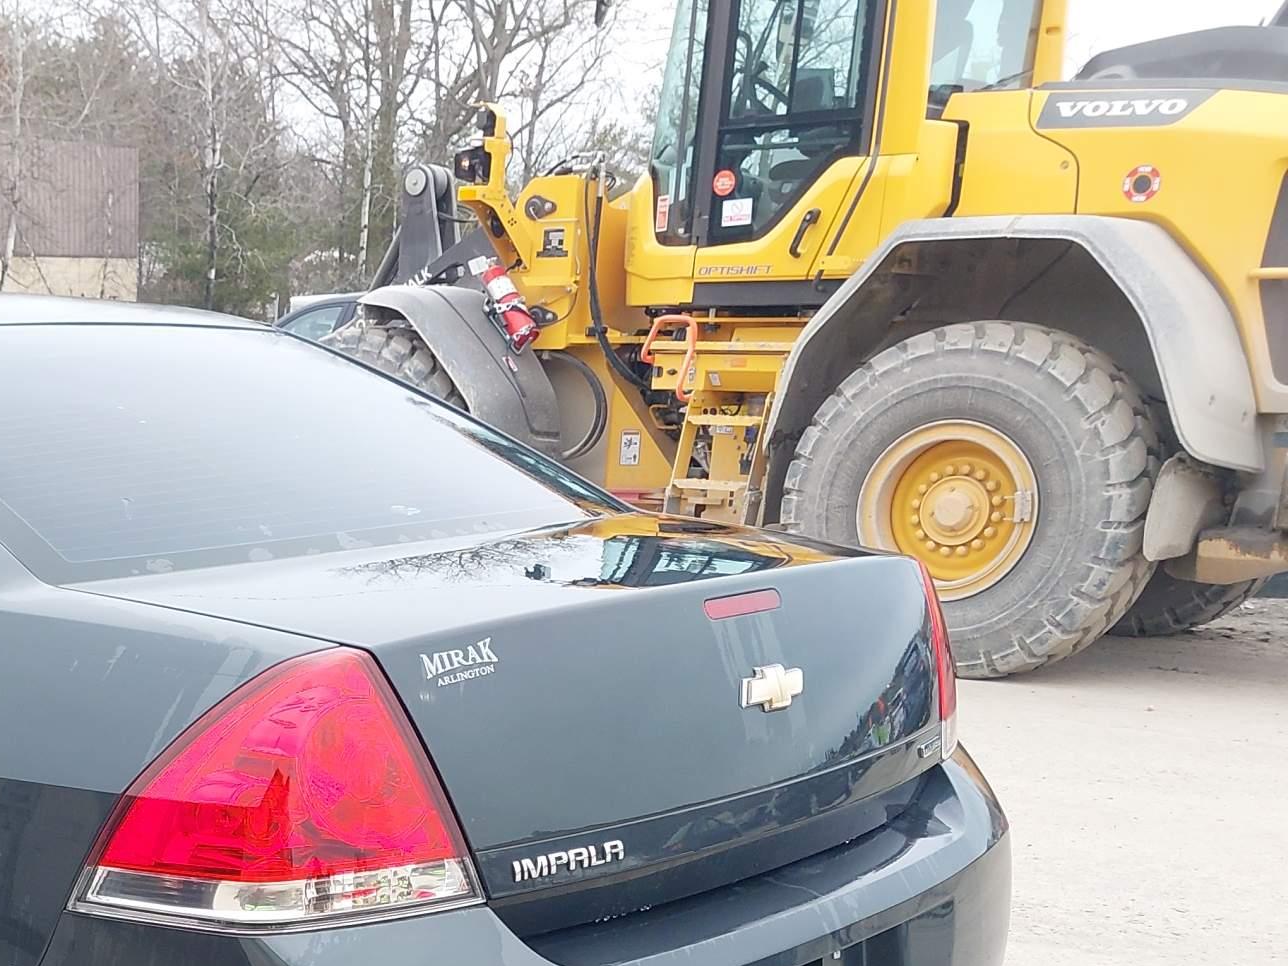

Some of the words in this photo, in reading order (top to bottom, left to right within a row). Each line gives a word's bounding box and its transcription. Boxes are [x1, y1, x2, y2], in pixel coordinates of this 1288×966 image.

[1055, 98, 1188, 117] VOLVO
[403, 266, 433, 289] ALK
[698, 264, 773, 276] OPTISHIFT
[419, 637, 498, 680] MIRAK
[437, 664, 495, 687] ARLINGTON
[512, 840, 624, 882] IMPALA
